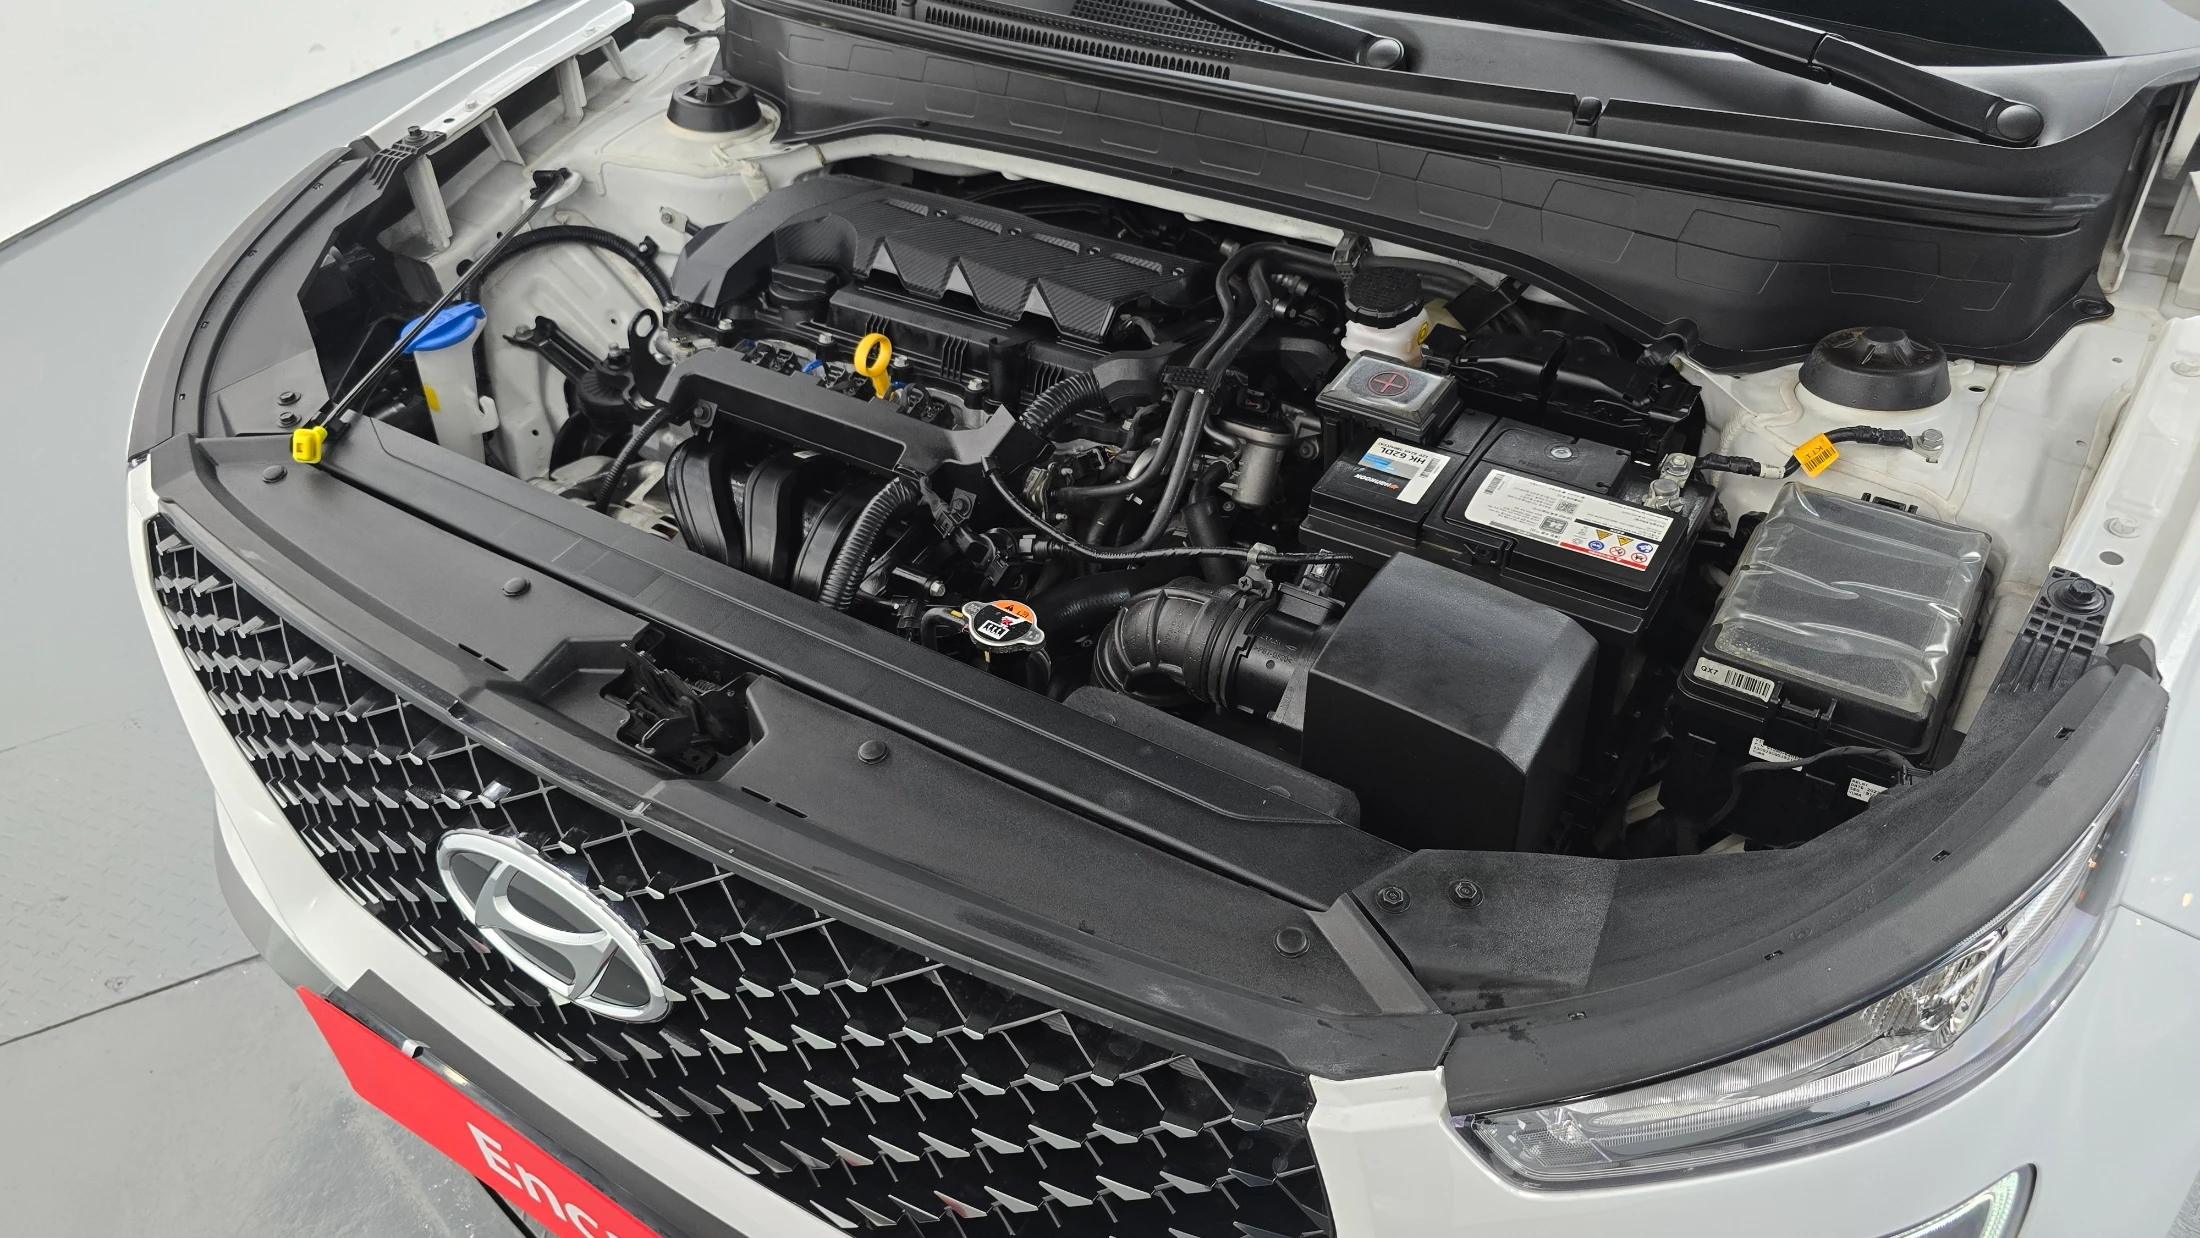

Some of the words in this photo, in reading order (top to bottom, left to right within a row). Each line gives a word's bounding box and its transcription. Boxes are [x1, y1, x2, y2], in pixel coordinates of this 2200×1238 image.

[1380, 446, 1407, 459] 62DL
[1408, 455, 1426, 465] HK
[1700, 665, 1718, 675] QX7
[466, 1120, 619, 1238] Enc
